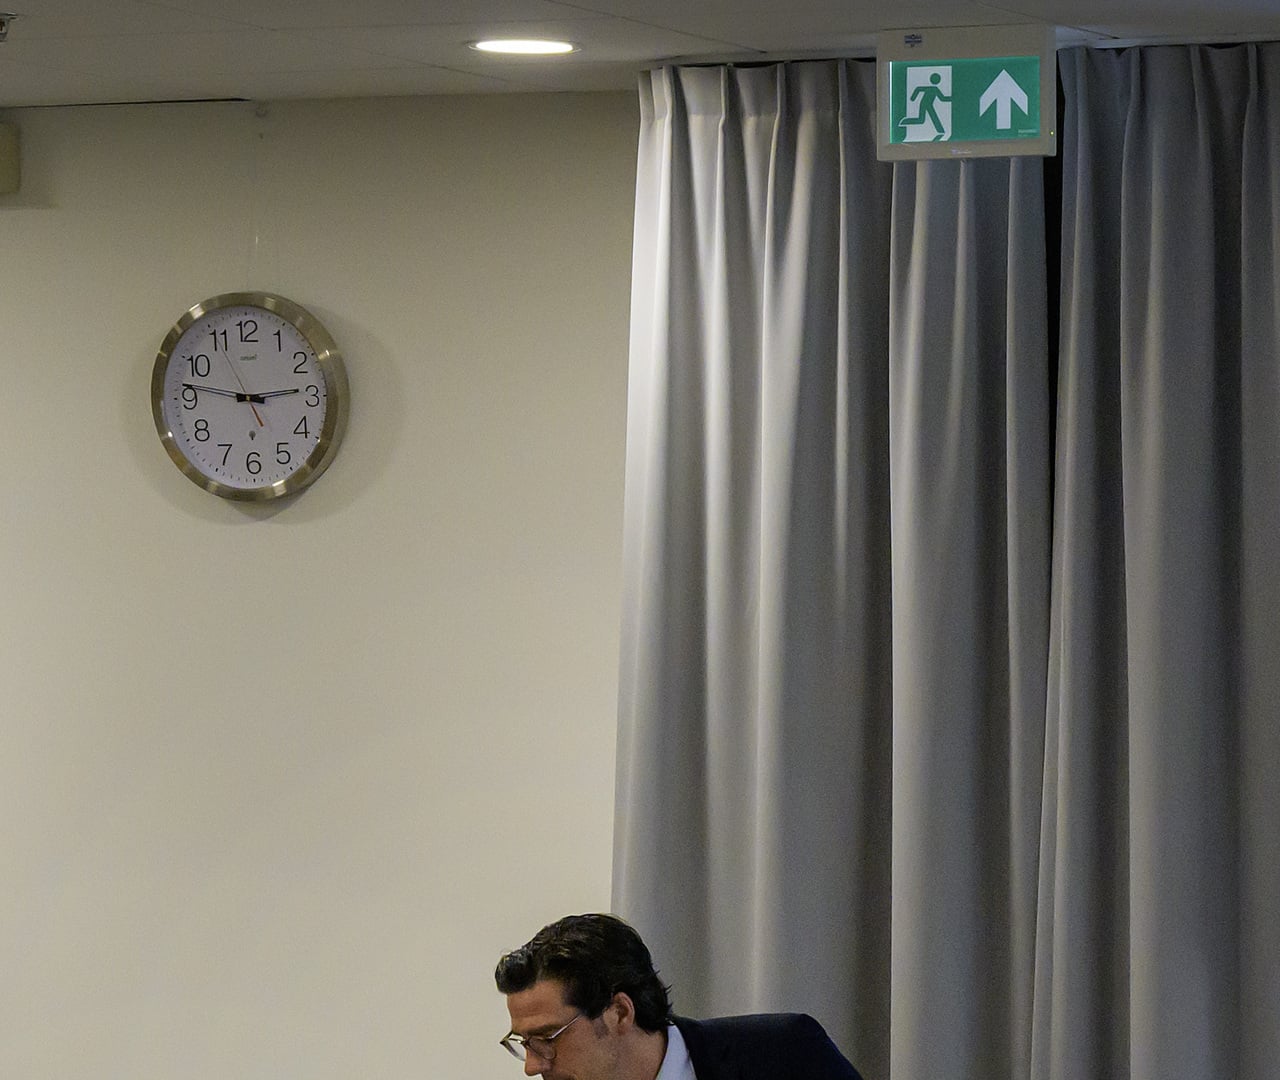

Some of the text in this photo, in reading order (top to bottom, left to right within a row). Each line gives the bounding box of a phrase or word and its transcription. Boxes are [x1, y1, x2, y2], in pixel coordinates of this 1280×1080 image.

[209, 329, 228, 352] 11
[236, 320, 259, 343] 12
[273, 329, 281, 353] 1
[187, 354, 211, 378] 10
[293, 351, 308, 374] 2
[182, 386, 198, 410] 9
[305, 385, 320, 407] 3
[194, 419, 210, 442] 8
[293, 415, 311, 439] 4
[217, 443, 233, 466] 7
[246, 451, 262, 475] 6
[276, 442, 291, 465] 5
